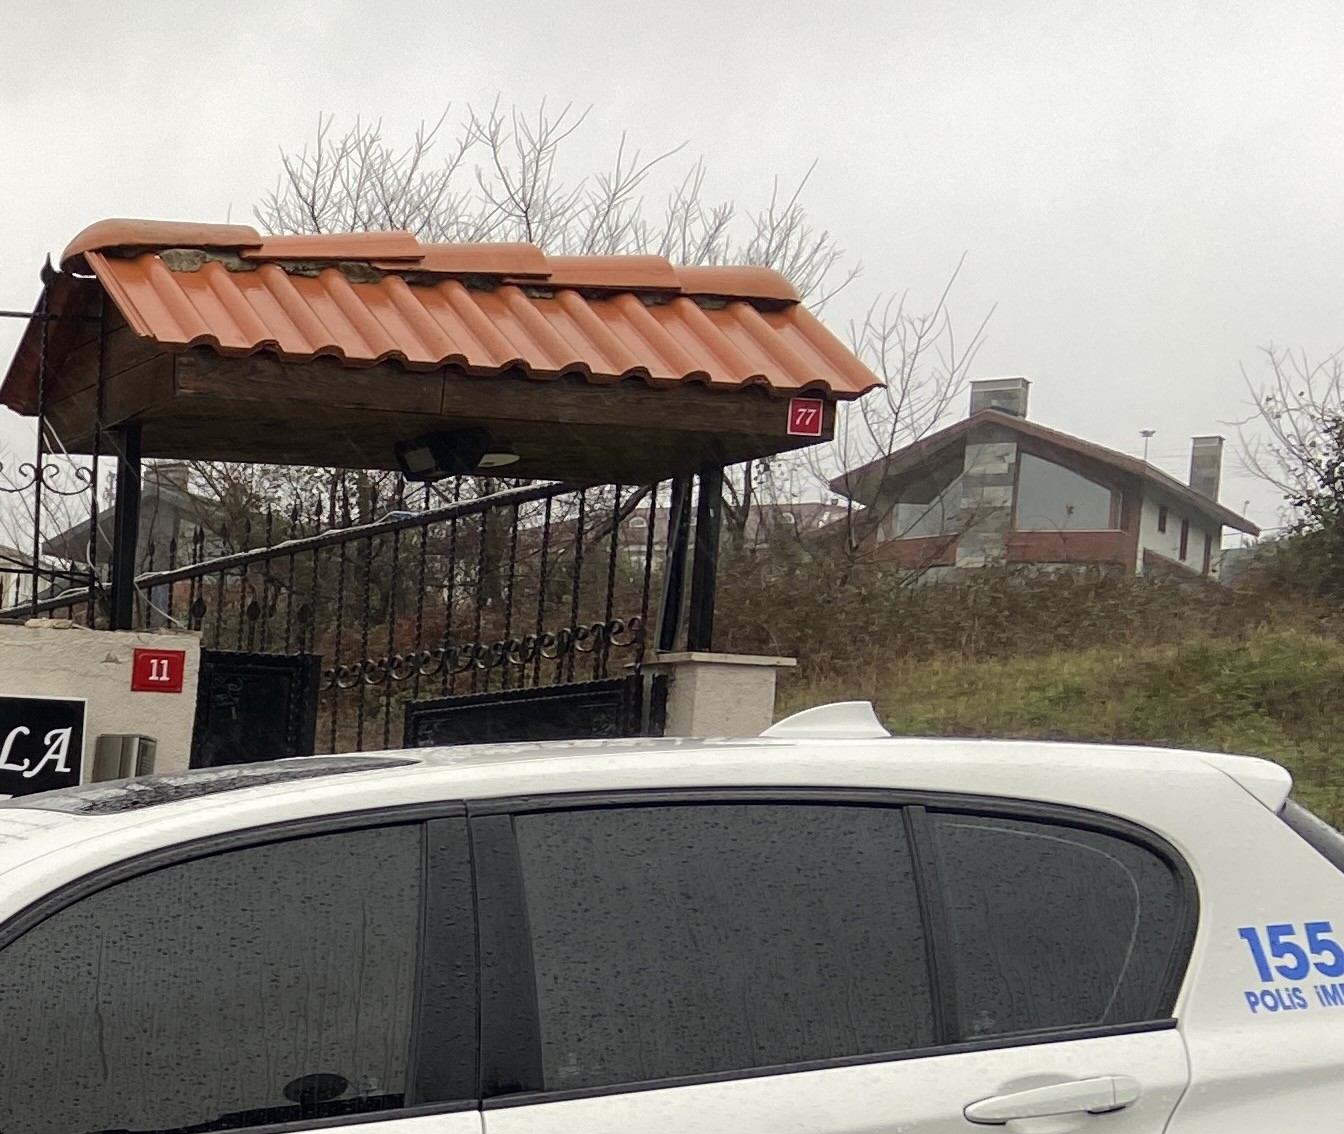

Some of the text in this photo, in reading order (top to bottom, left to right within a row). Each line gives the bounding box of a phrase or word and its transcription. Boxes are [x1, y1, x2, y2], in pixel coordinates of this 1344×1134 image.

[795, 408, 817, 426] 77
[148, 658, 170, 682] 11
[1238, 921, 1344, 982] 155
